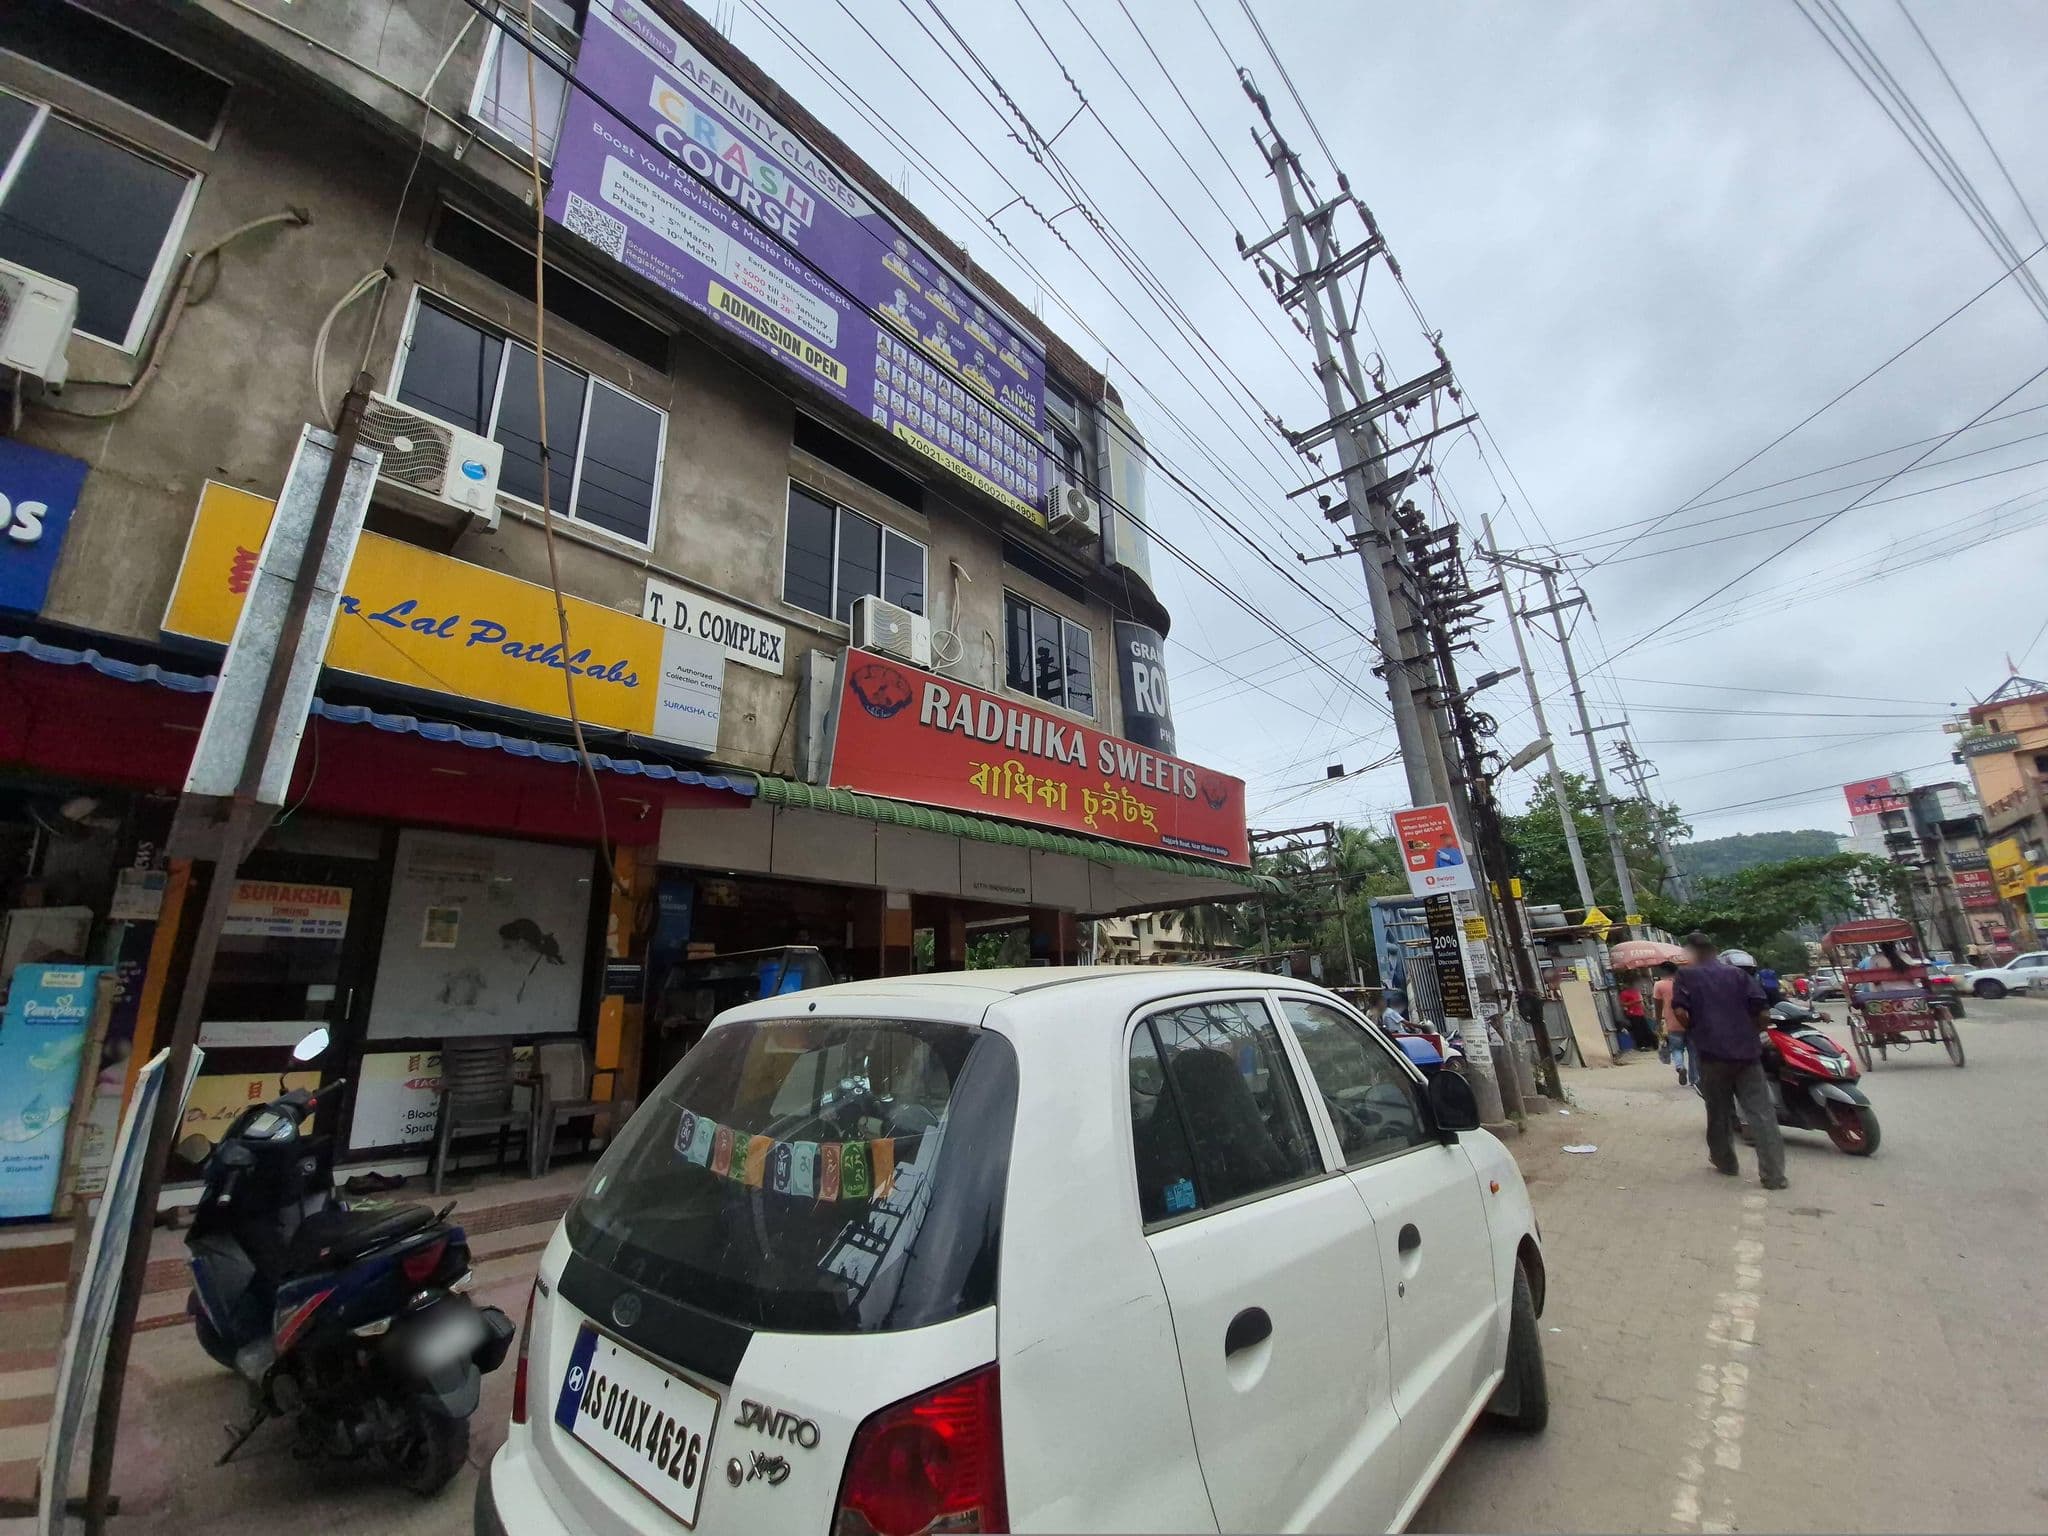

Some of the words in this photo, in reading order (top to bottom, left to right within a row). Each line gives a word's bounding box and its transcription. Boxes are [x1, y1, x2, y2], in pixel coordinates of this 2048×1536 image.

[680, 58, 777, 141] AFFINITY
[781, 140, 857, 209] CLASSES
[658, 89, 811, 220] CRASH
[668, 161, 699, 187] FOR
[622, 169, 650, 192] Batch
[652, 187, 687, 219] Starting
[687, 212, 712, 236] From
[655, 123, 802, 246] COURSE
[592, 121, 635, 158] Boost
[639, 153, 671, 183] Your
[674, 176, 728, 223] Revision
[730, 219, 741, 232] &
[742, 227, 781, 260] Master
[784, 257, 803, 275] the
[804, 271, 851, 311] Concepts
[612, 192, 646, 220] Phase
[686, 241, 718, 267] March
[614, 181, 647, 208] Phase
[683, 226, 715, 253] March
[795, 302, 829, 330] January
[797, 314, 835, 344] February
[719, 291, 801, 356] ADMISSION
[804, 346, 840, 381] OPEN
[1001, 384, 1036, 418] AIIMS
[1016, 382, 1036, 403] OUR
[368, 600, 460, 639] Lal
[650, 591, 667, 626] T.
[673, 601, 692, 634] D.
[699, 611, 782, 664] COMPLEX
[665, 671, 699, 687] Collection
[700, 681, 721, 692] Centre
[677, 664, 713, 681] Authorized
[663, 699, 706, 716] SURAKSHA
[920, 682, 1087, 770] RADHIKA
[1098, 740, 1198, 800] SWEETS
[239, 883, 342, 905] SURAKSHA
[1433, 935, 1457, 950] 20%
[24, 999, 88, 1019] Pampers
[734, 1398, 820, 1449] SANTRO
